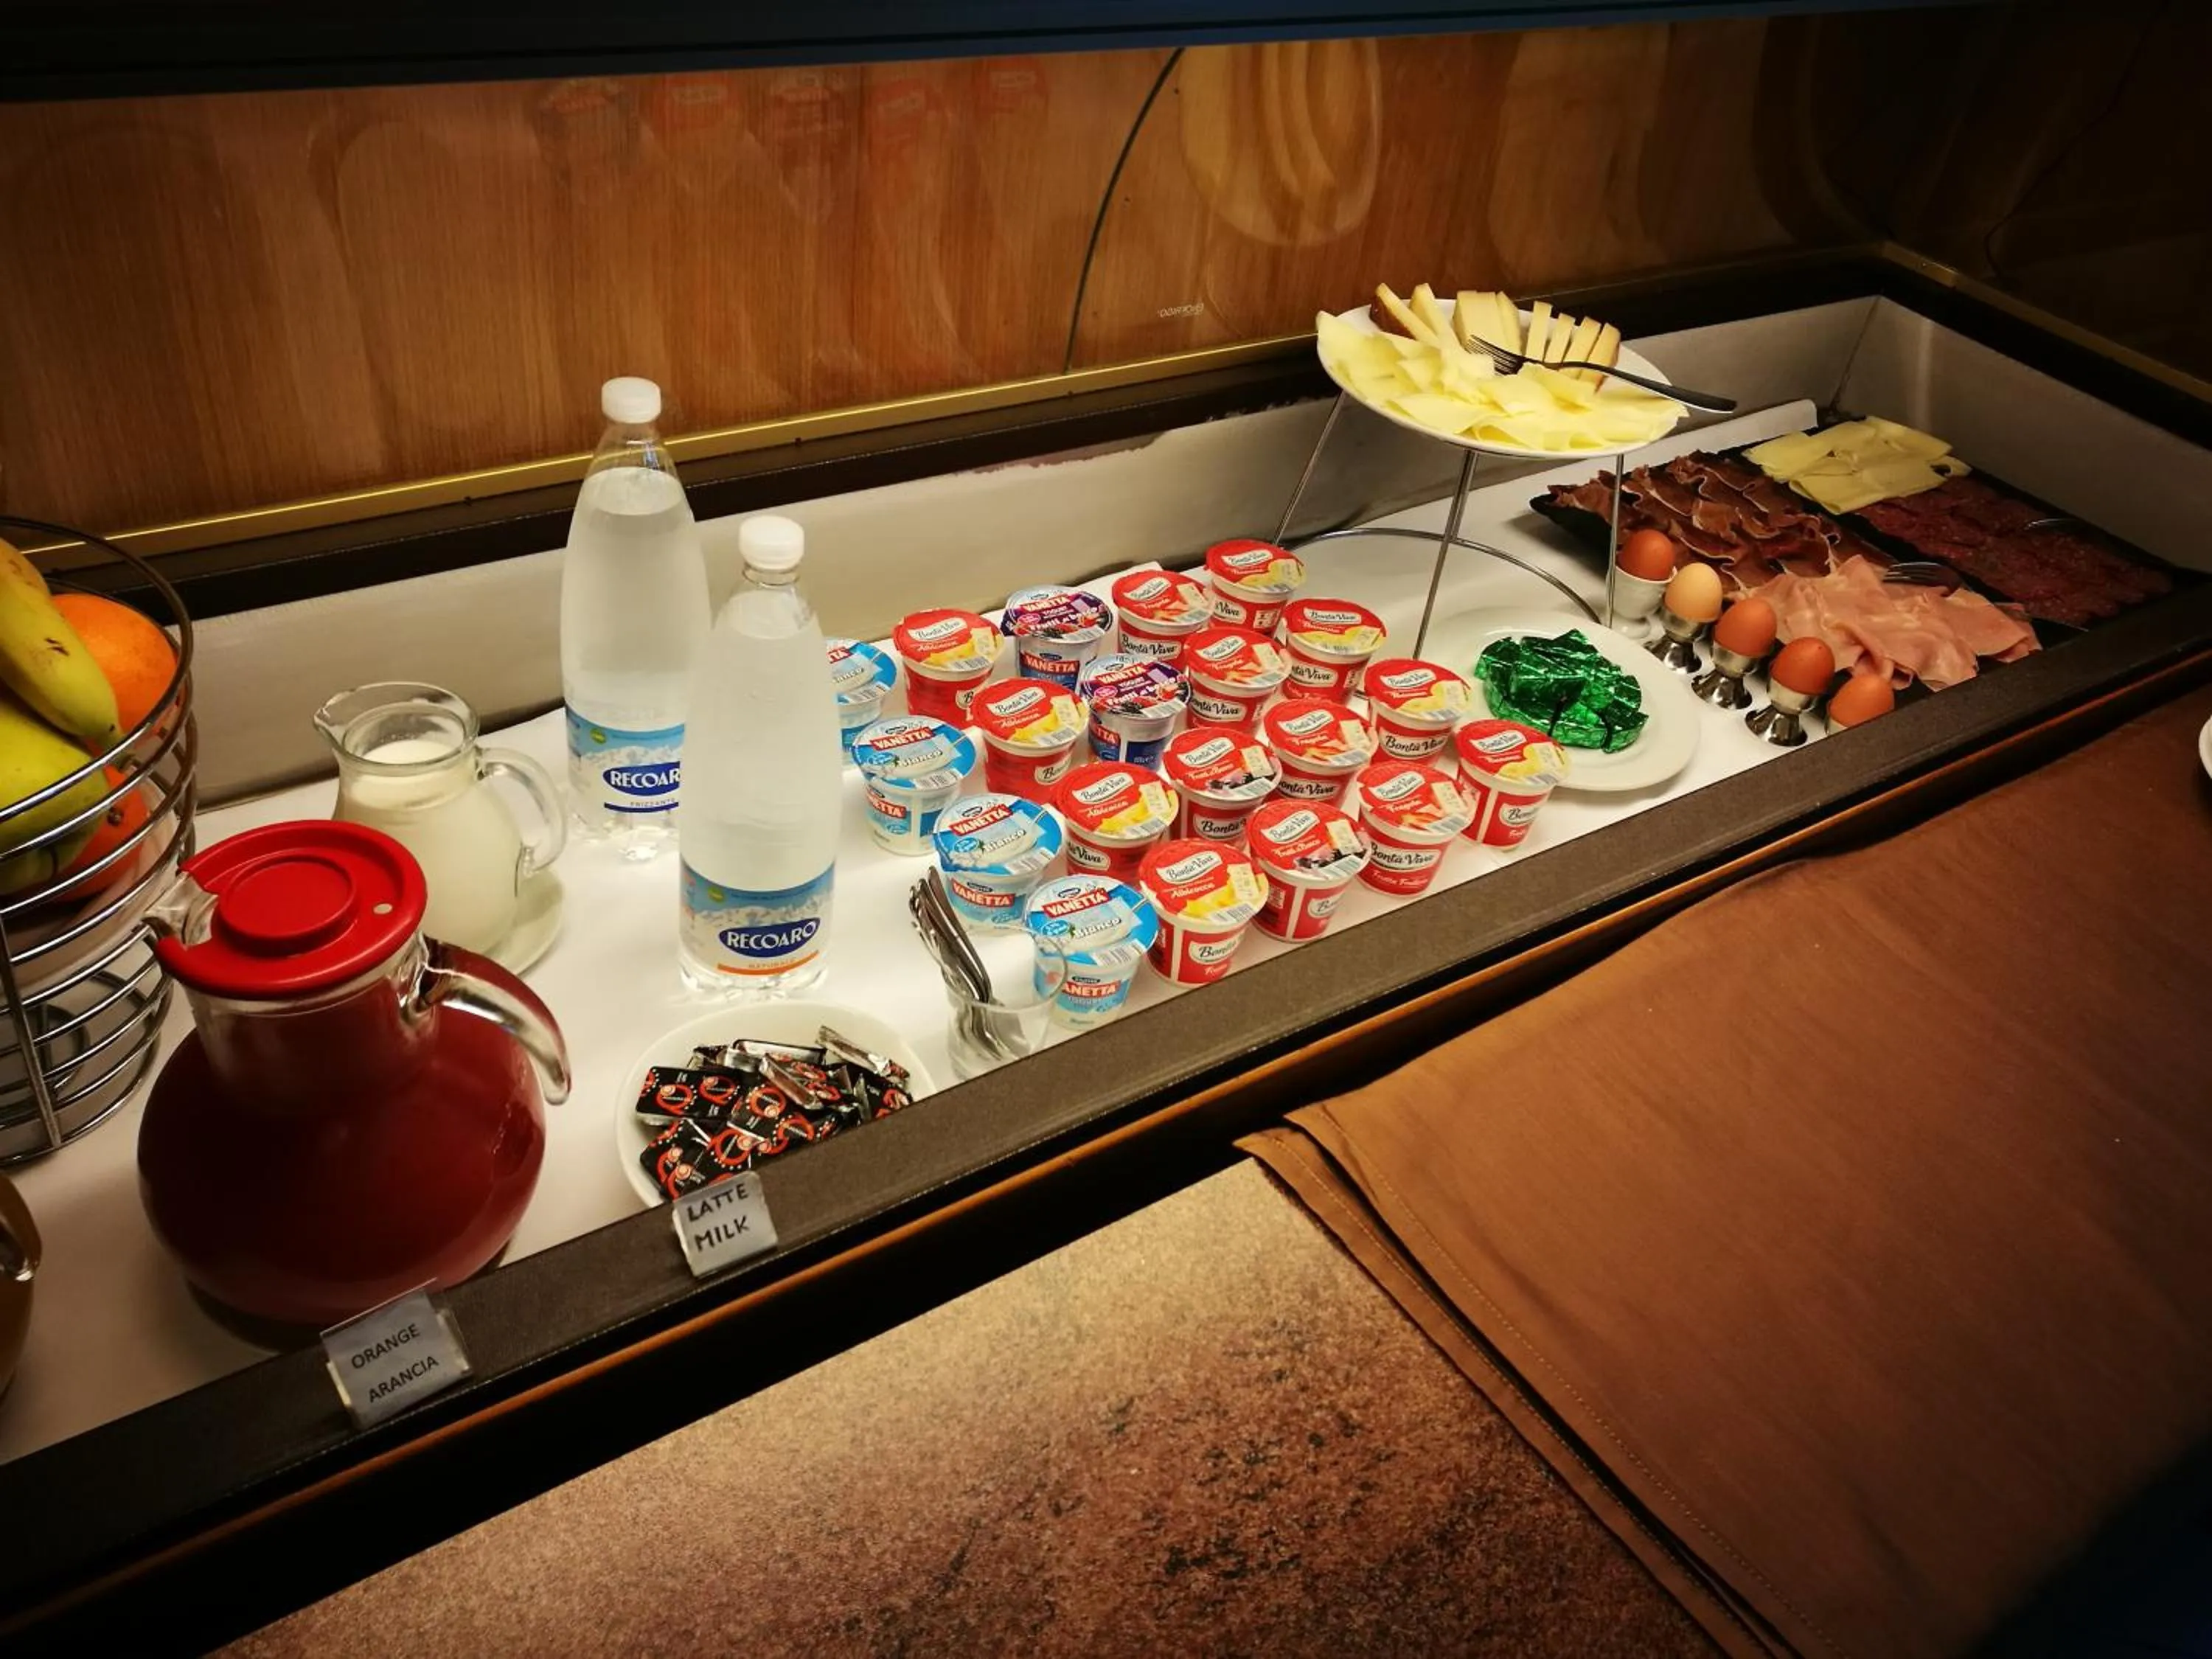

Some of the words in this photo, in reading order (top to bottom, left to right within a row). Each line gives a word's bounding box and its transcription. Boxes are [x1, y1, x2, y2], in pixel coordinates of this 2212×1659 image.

[1024, 596, 1068, 611] VANETTA
[1150, 642, 1176, 655] Viva
[1025, 655, 1077, 672] VANETTA
[1305, 667, 1332, 681] Viva
[1098, 665, 1147, 684] VANETTA
[1212, 703, 1239, 715] Viva
[874, 728, 931, 749] VANETTA
[610, 767, 680, 789] RECOAR
[1306, 783, 1335, 796] Viva
[953, 809, 1009, 834] VANETTA
[1075, 845, 1103, 863] Viva
[953, 882, 1011, 906] VANETTA
[1046, 892, 1107, 916] VANETTA
[726, 921, 817, 950] RECOARO
[1063, 984, 1117, 998] ANETTA
[686, 1183, 749, 1222] LATTE
[694, 1214, 750, 1253] MILK
[351, 1323, 421, 1370] ORANGE
[369, 1355, 440, 1404] ARANCIA
